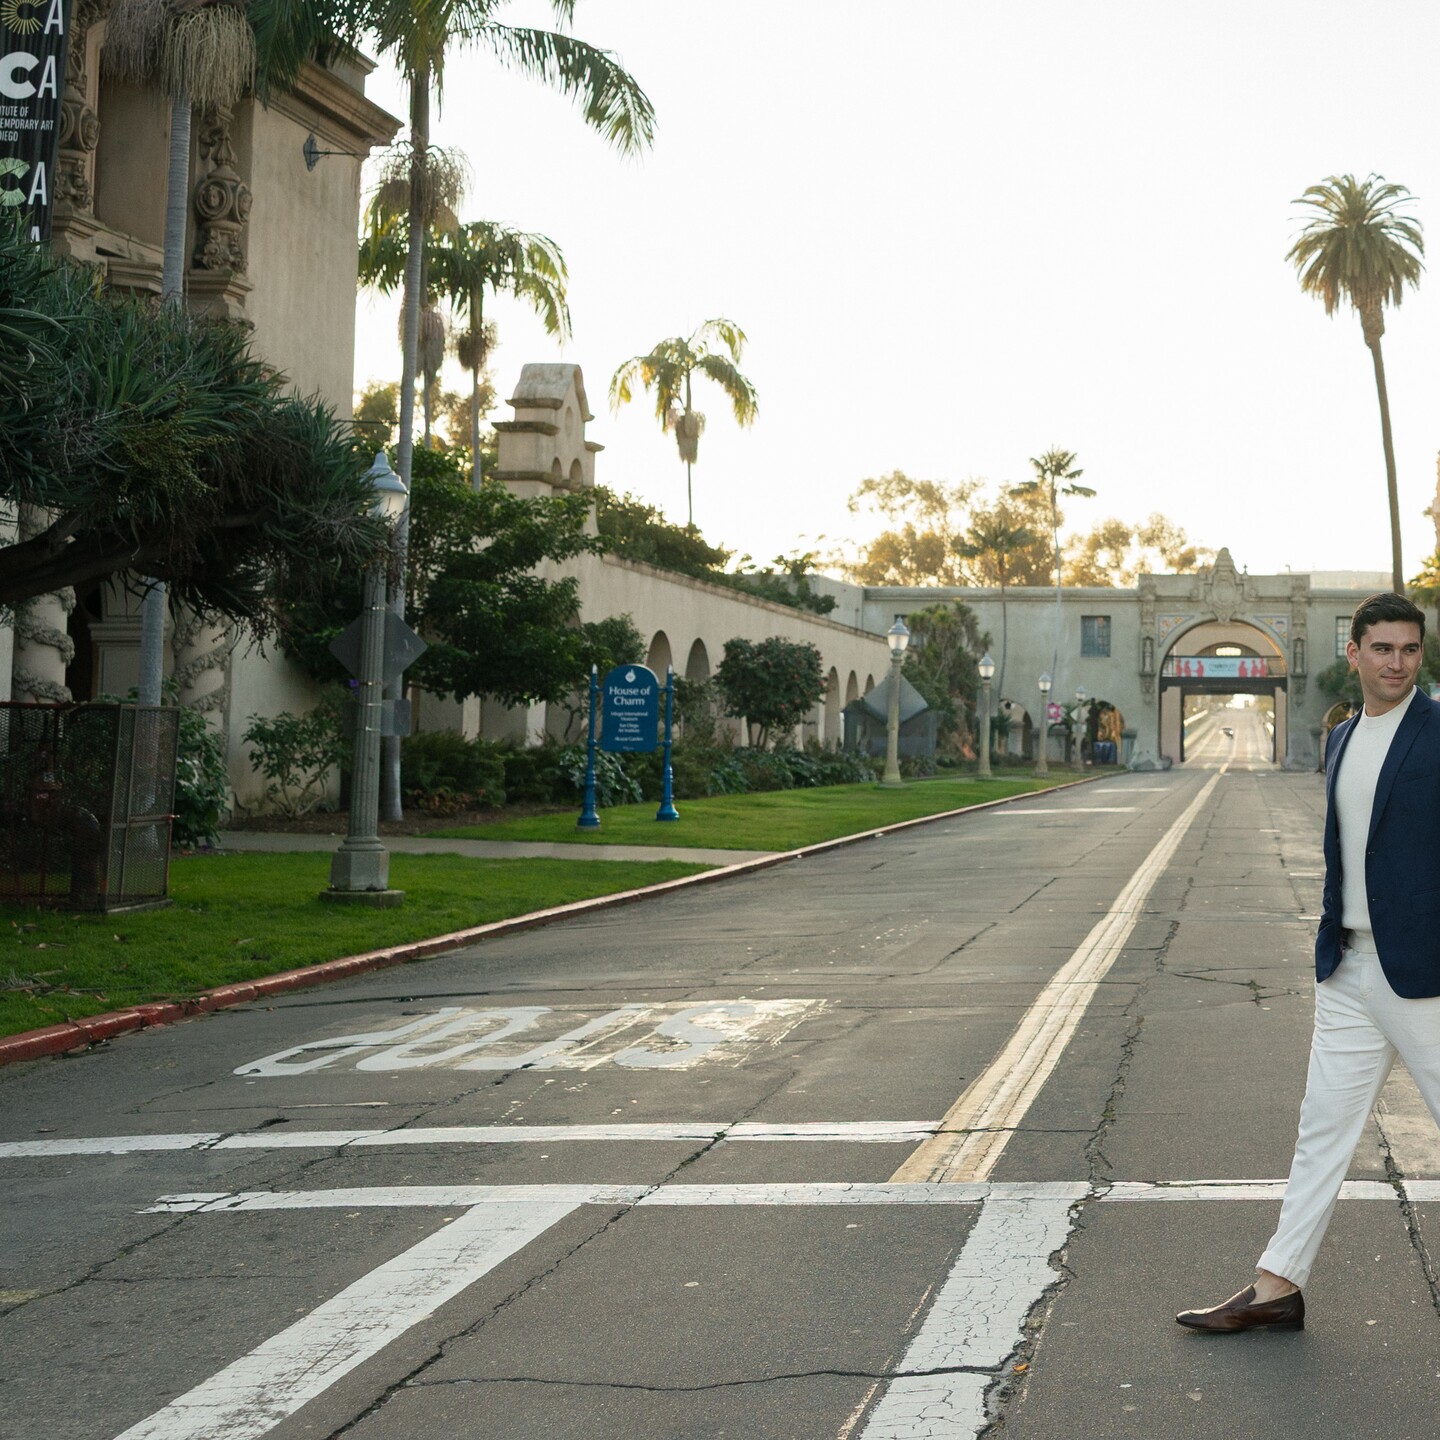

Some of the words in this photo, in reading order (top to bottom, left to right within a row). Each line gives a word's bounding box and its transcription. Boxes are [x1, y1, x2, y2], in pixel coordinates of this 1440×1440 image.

[0, 51, 57, 99] CA
[20, 106, 29, 118] OF
[40, 120, 54, 131] ART
[609, 686, 639, 695] House
[640, 686, 651, 695] of
[613, 696, 645, 706] Charm
[232, 1002, 764, 1078] STOP
